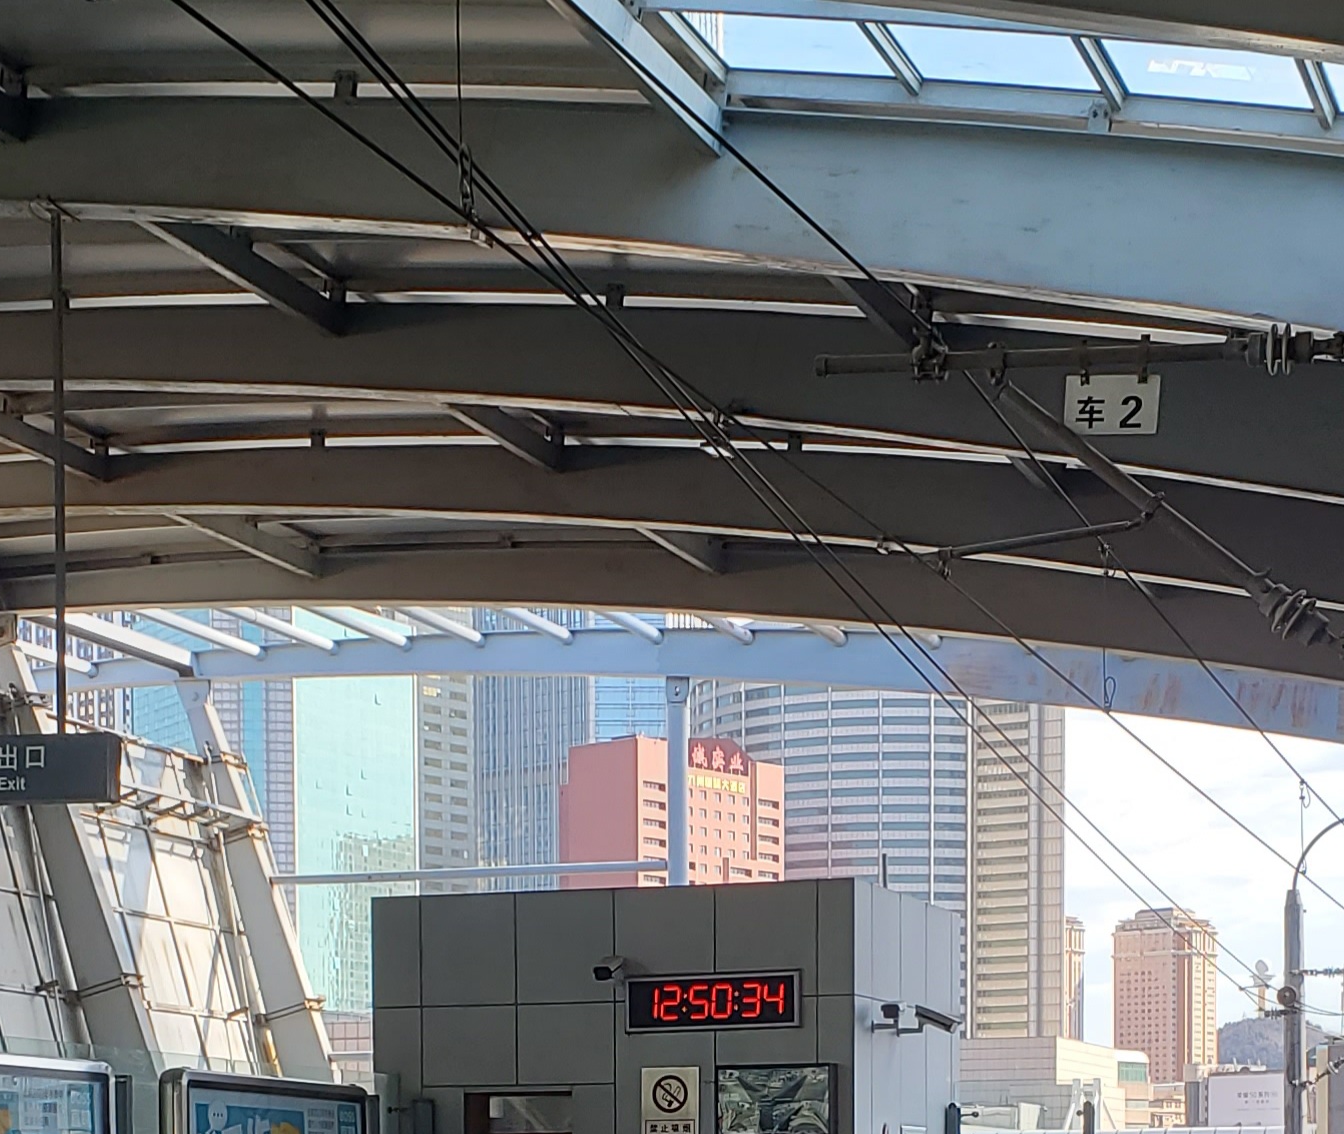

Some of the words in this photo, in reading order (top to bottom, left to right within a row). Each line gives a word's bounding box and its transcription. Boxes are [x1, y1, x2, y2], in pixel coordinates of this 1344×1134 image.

[1075, 396, 1105, 429] 车
[1119, 395, 1143, 429] 2
[650, 982, 786, 1021] 12:50:34
[650, 1123, 691, 1133] 禁止吸烟
